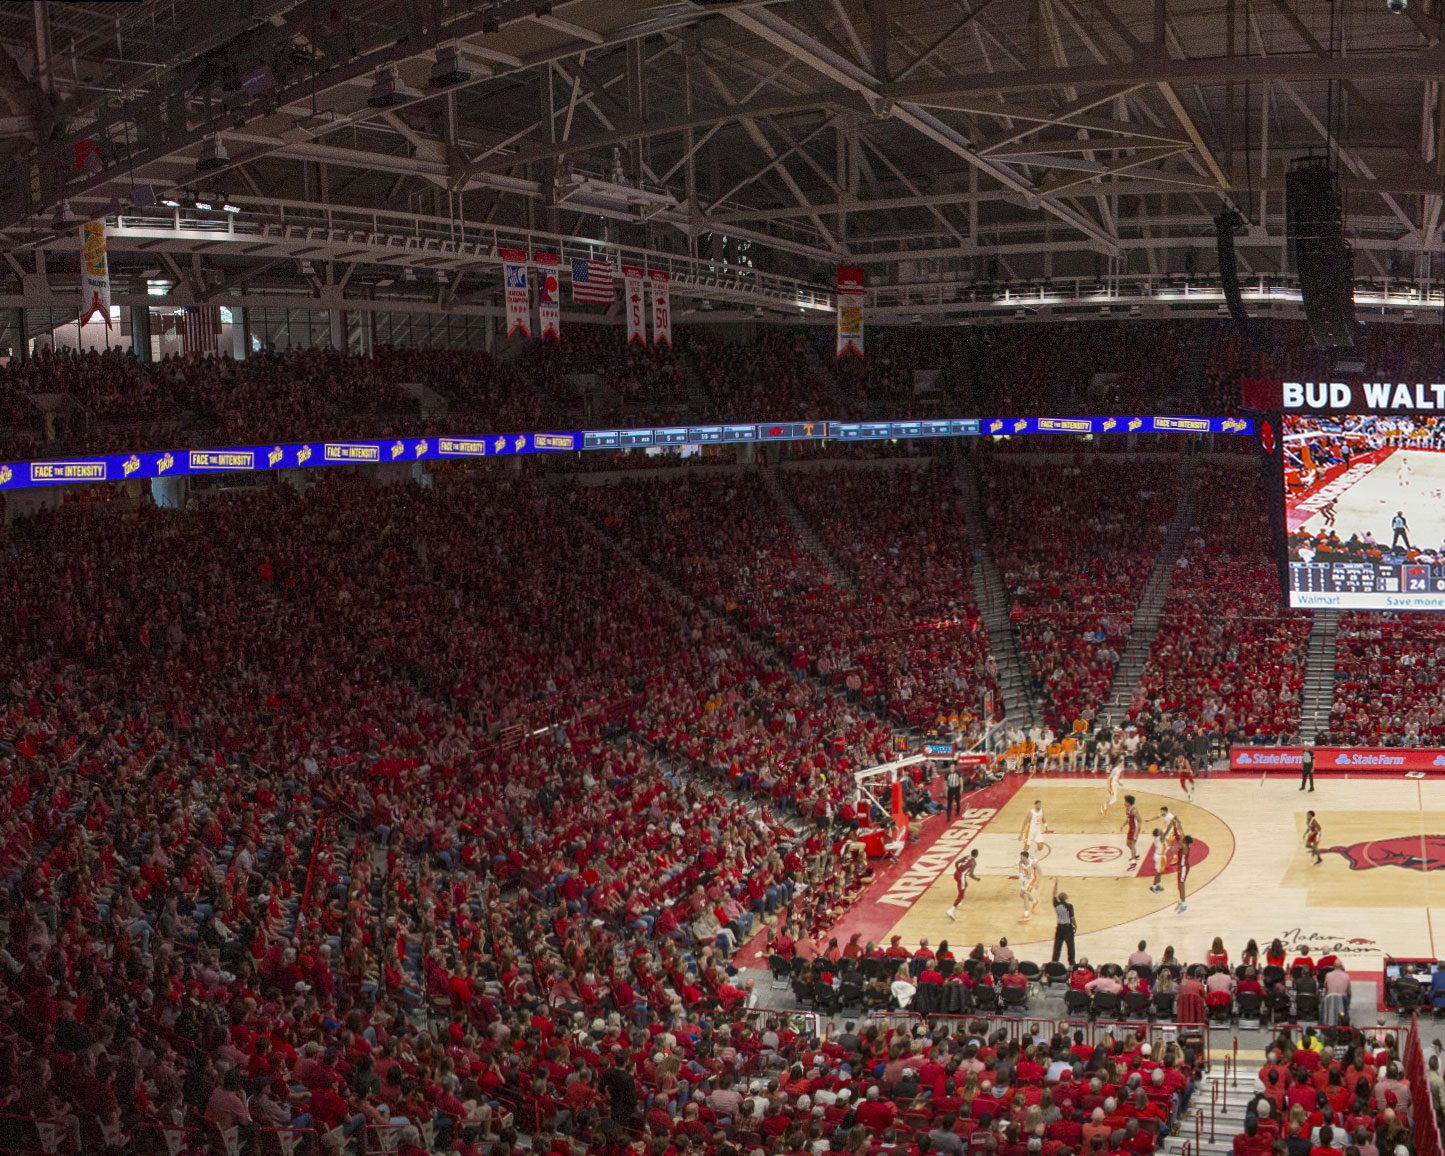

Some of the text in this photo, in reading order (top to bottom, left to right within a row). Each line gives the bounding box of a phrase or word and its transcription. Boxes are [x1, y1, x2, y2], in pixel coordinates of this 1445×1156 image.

[633, 306, 640, 326] 5
[656, 308, 668, 328] 50
[1282, 383, 1352, 408] BUD
[1041, 420, 1054, 428] FACE
[1061, 421, 1090, 430] INTENSITY
[1178, 420, 1207, 430] INTENSITY
[327, 446, 341, 458] FACE
[349, 448, 377, 458] INTENSITY
[441, 442, 452, 451] FACE
[460, 442, 483, 452] INTENSITY
[156, 455, 174, 475] Takis
[192, 454, 208, 465] FACE
[218, 455, 251, 466] INTENSITY
[268, 450, 283, 468] Takis
[34, 466, 53, 478] FACE
[65, 466, 102, 478] INTENSITY
[122, 458, 140, 478] Takis
[1410, 580, 1426, 590] 24
[1298, 596, 1340, 604] Walmart
[1386, 597, 1412, 606] Save
[876, 807, 998, 907] ARKANSAS
[1280, 928, 1345, 944] Nolan
